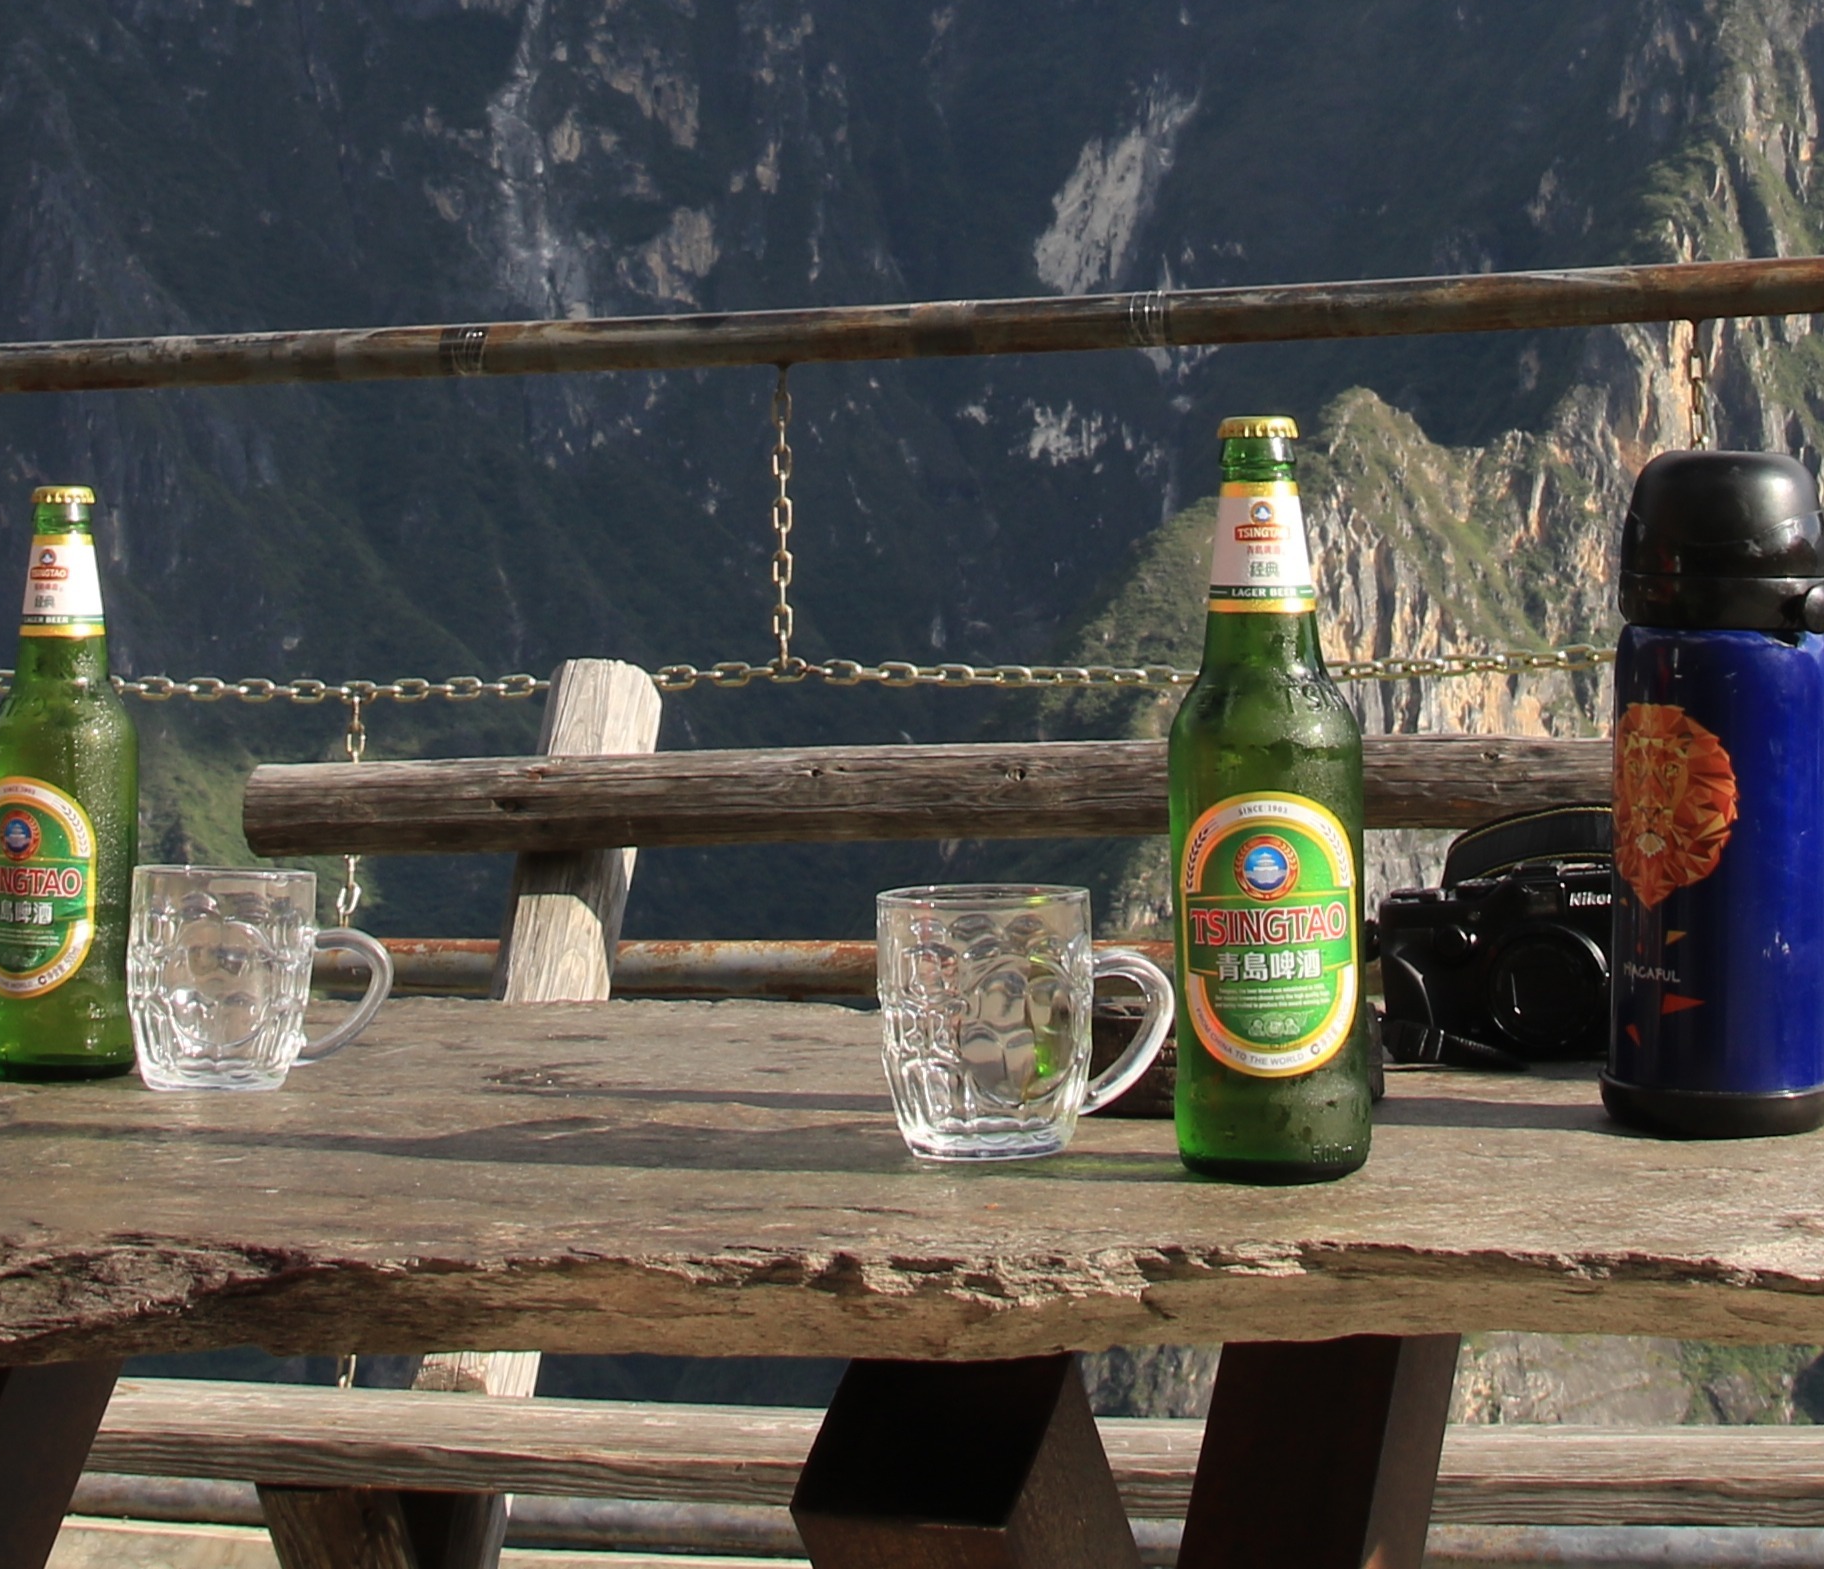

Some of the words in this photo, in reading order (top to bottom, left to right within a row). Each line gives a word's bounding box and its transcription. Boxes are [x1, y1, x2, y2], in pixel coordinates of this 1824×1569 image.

[1250, 560, 1279, 578] 经典
[1231, 587, 1266, 597] LAGER
[1269, 587, 1297, 597] BEER
[1238, 803, 1264, 816] SINCE
[1189, 901, 1348, 947] TSINGTAO
[1216, 948, 1323, 982] 青島啤酒
[1196, 1006, 1211, 1034] FROM
[1209, 1032, 1234, 1056] CHINA
[1234, 1049, 1248, 1062] TO
[1249, 1054, 1268, 1066] THE
[1270, 1052, 1305, 1067] WORLD
